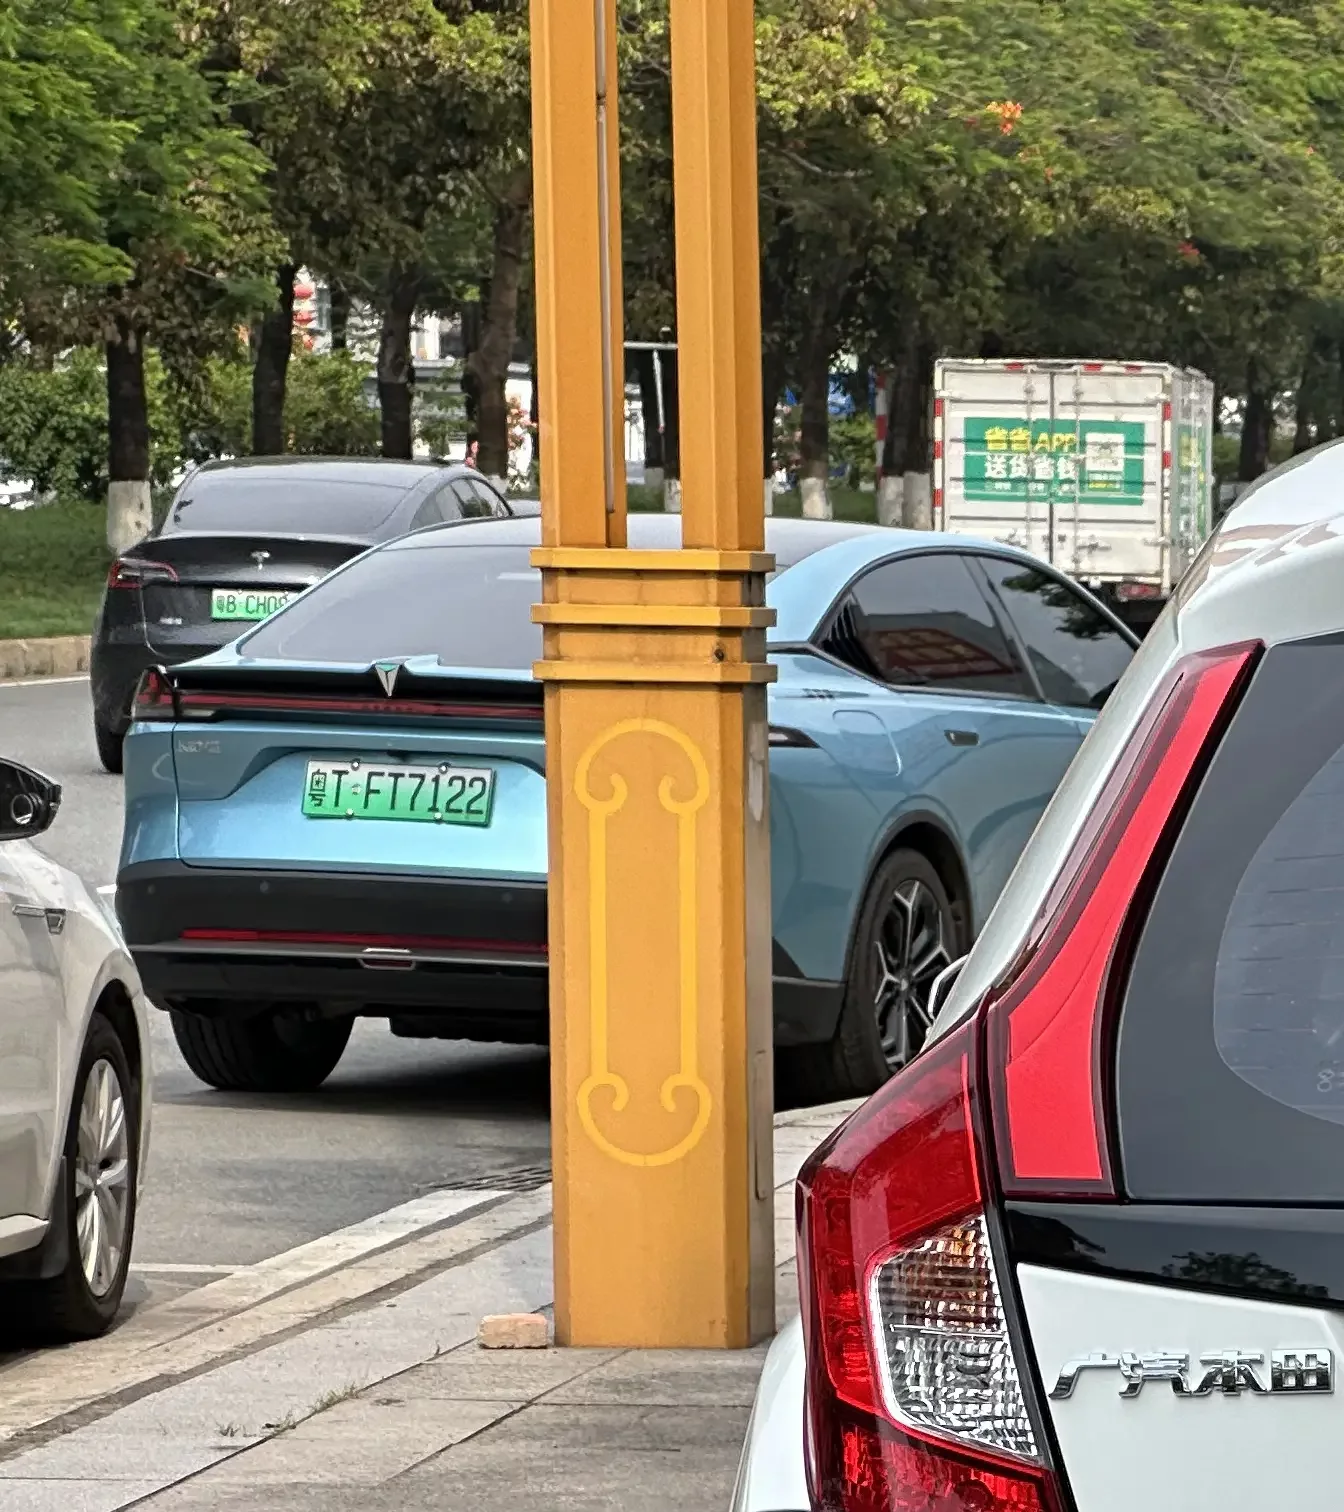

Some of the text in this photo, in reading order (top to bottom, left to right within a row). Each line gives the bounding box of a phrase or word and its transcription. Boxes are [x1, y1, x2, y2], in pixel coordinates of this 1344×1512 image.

[984, 426, 1077, 452] 省省APP
[1048, 1348, 1335, 1398] 广汽本田
